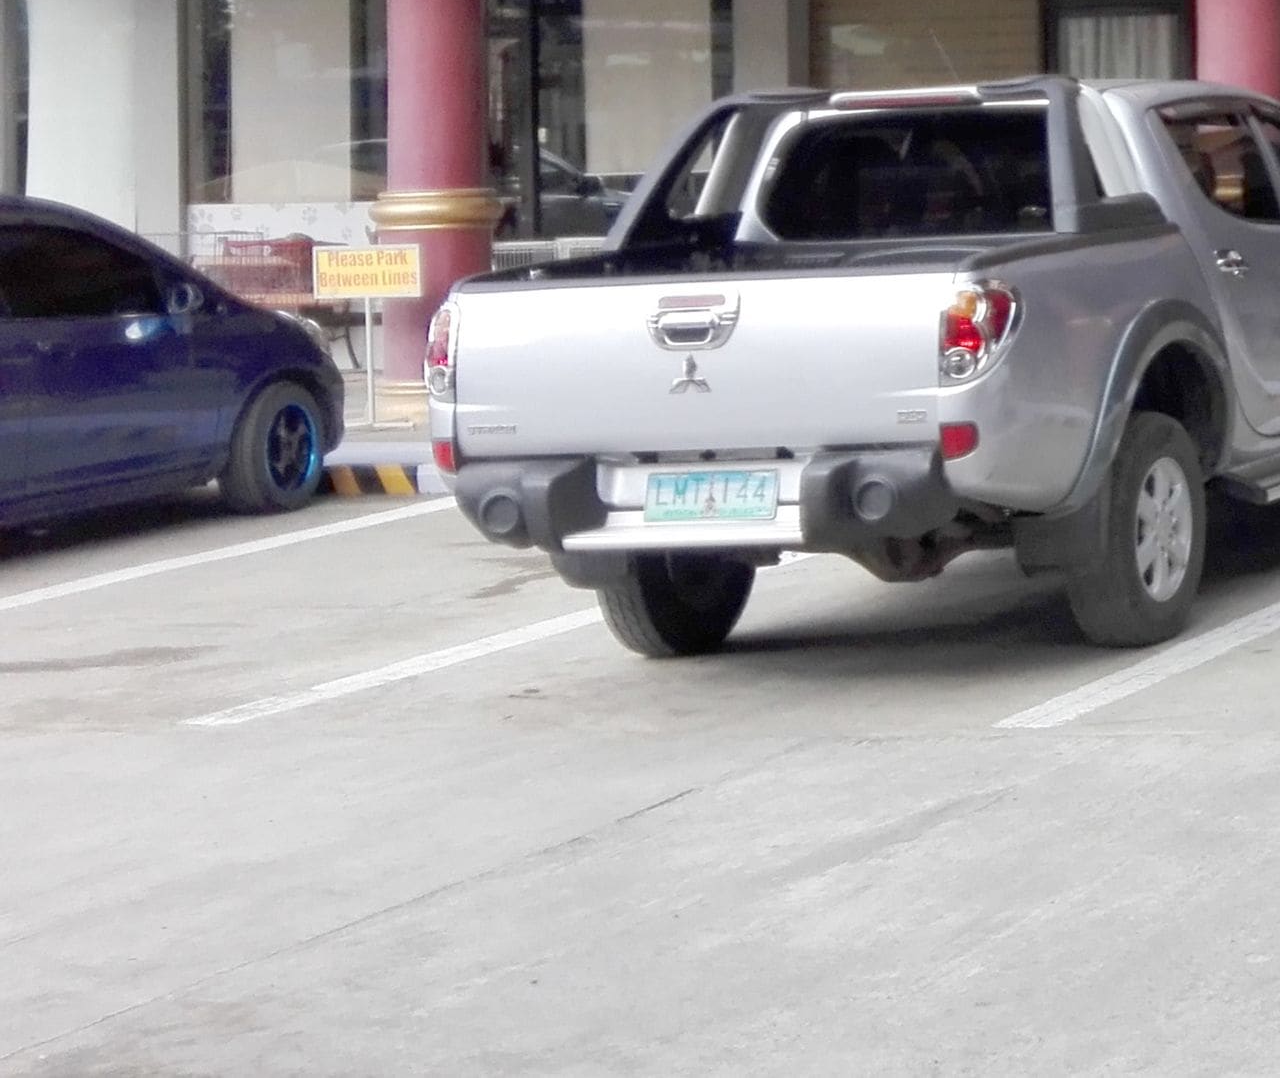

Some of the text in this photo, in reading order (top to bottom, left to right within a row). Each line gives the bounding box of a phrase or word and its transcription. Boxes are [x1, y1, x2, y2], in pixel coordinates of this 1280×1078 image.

[327, 249, 409, 267] Please Park
[320, 269, 418, 288] Between Lines
